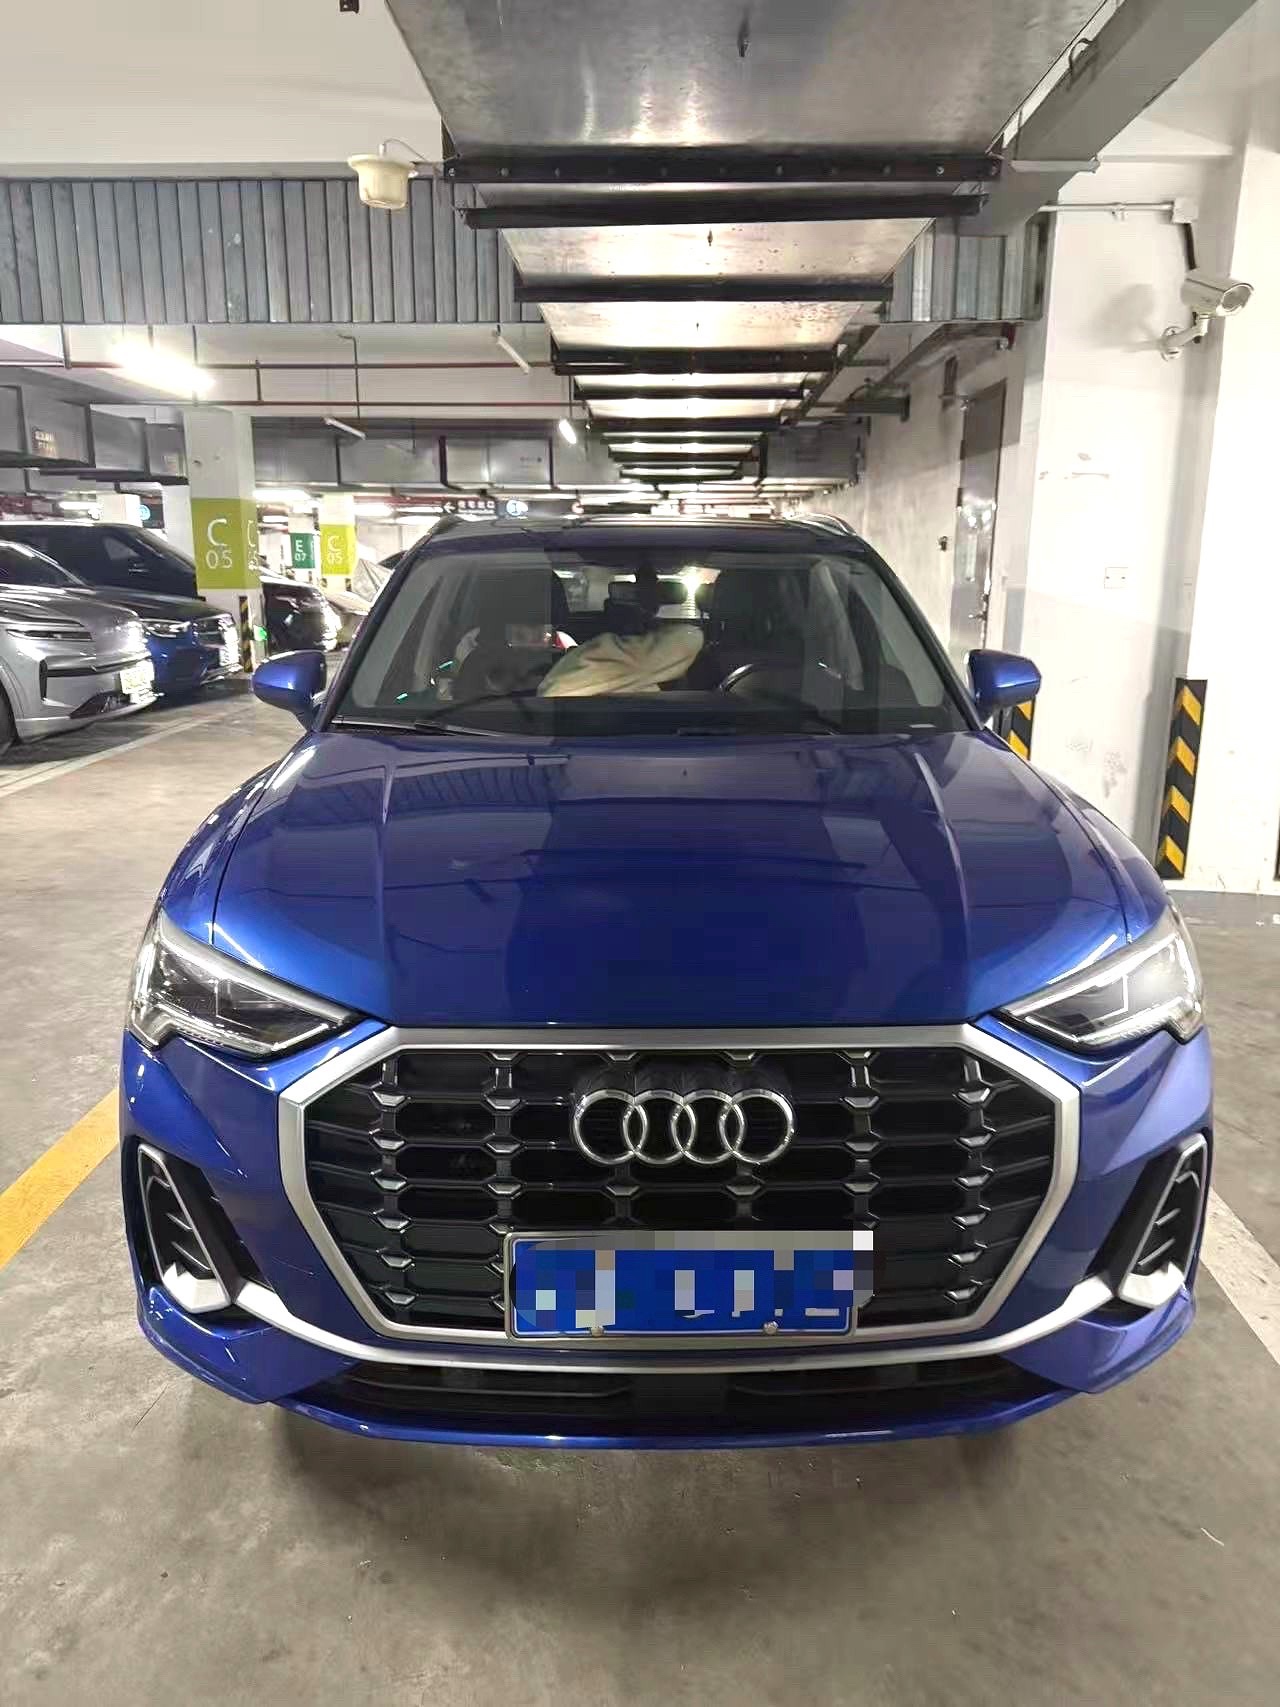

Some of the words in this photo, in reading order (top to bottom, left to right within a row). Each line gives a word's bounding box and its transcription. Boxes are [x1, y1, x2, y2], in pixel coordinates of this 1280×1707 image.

[207, 518, 228, 546] C
[295, 539, 304, 553] E
[328, 535, 342, 552] C
[206, 550, 232, 569] 05
[294, 553, 307, 561] 07
